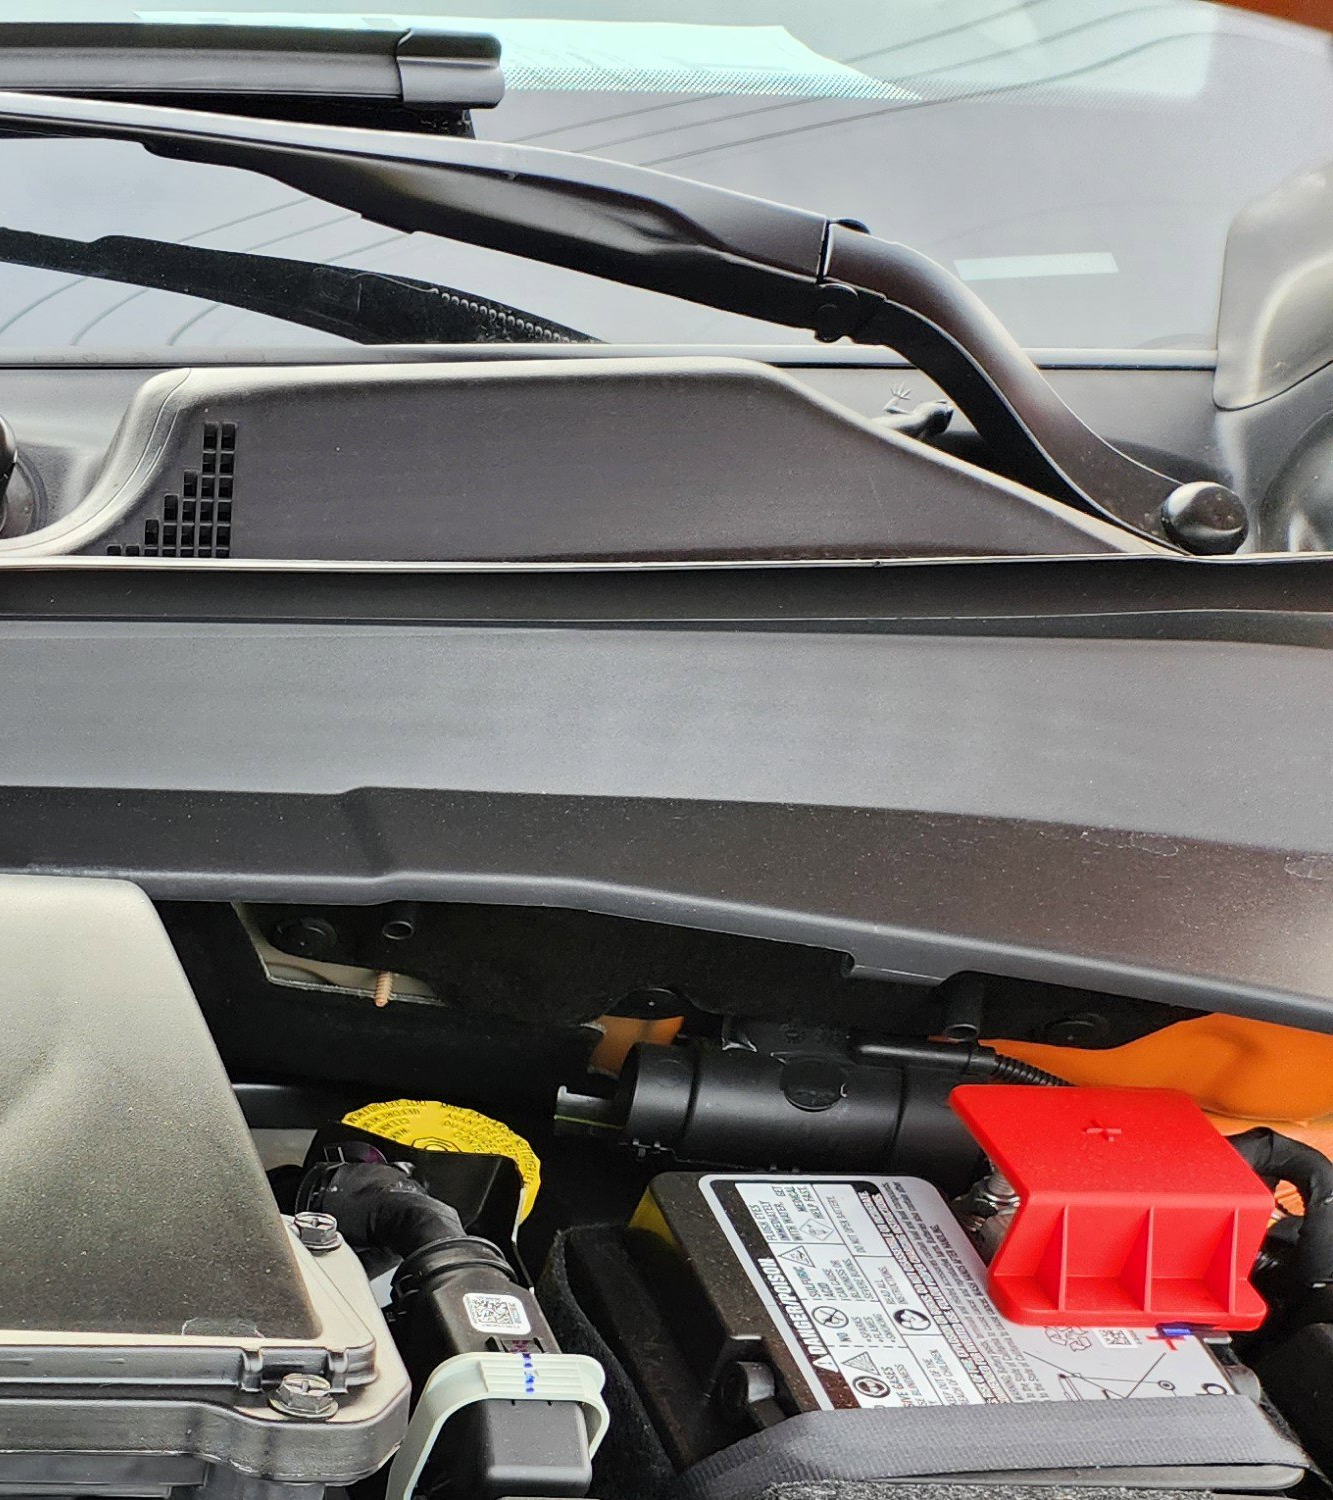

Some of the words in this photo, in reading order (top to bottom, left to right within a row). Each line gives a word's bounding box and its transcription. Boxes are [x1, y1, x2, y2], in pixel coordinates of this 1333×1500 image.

[747, 1204, 766, 1219] EYES
[757, 1257, 827, 1354] DANGER/POISON
[835, 1332, 852, 1342] NO
